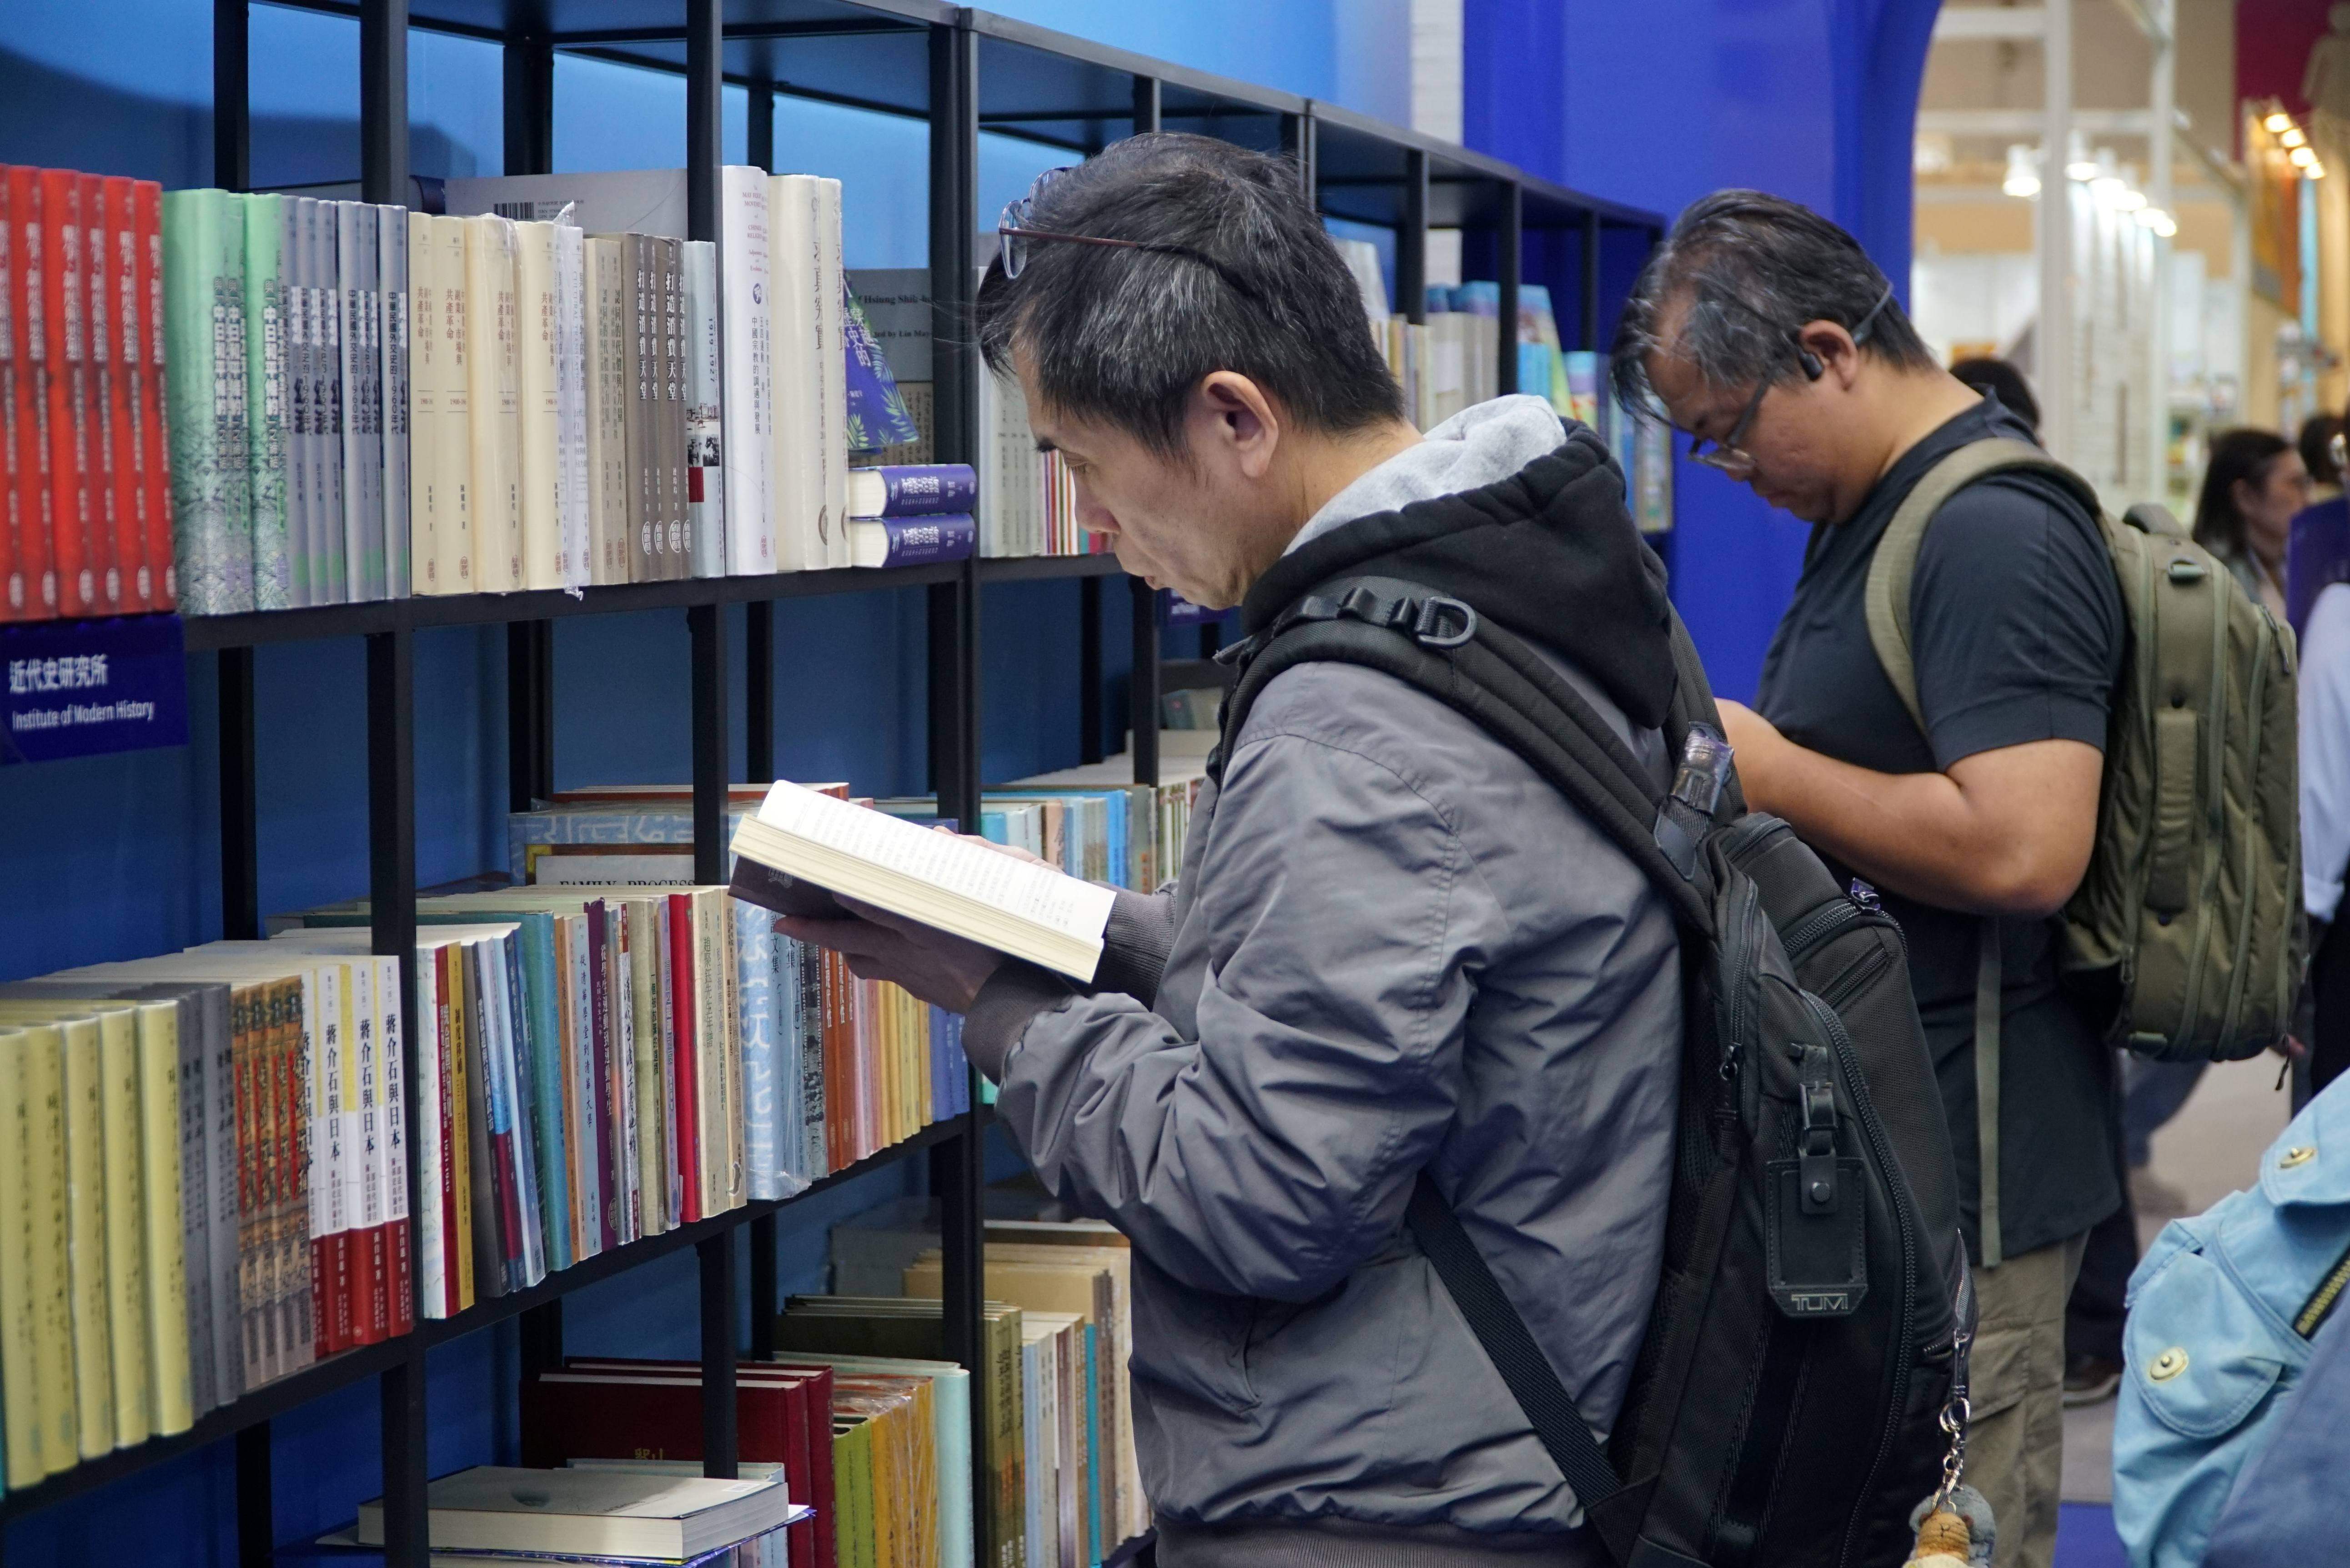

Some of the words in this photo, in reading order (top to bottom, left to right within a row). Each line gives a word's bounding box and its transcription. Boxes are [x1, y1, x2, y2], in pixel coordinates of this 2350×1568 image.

[446, 288, 454, 340] 共產革命
[637, 269, 648, 401] 打造消費天堂
[649, 271, 658, 401] 打造消費天堂
[665, 272, 677, 401] 打造消費天堂
[708, 318, 716, 383] 1919-1927
[752, 316, 761, 435] 中國宗教的調適與發展
[9, 654, 108, 694] 近代史研究所
[12, 708, 58, 731] Institute
[60, 704, 73, 727] of
[74, 702, 114, 724] Modern
[116, 699, 155, 722] History
[326, 1023, 342, 1162] 蔣介石與日本
[359, 1019, 375, 1156] 蔣介石與日本
[386, 1014, 401, 1151] 蔣介石與日本
[580, 954, 593, 1128] 從清華學堂到清華大學
[1791, 1293, 1848, 1311] TUMI
